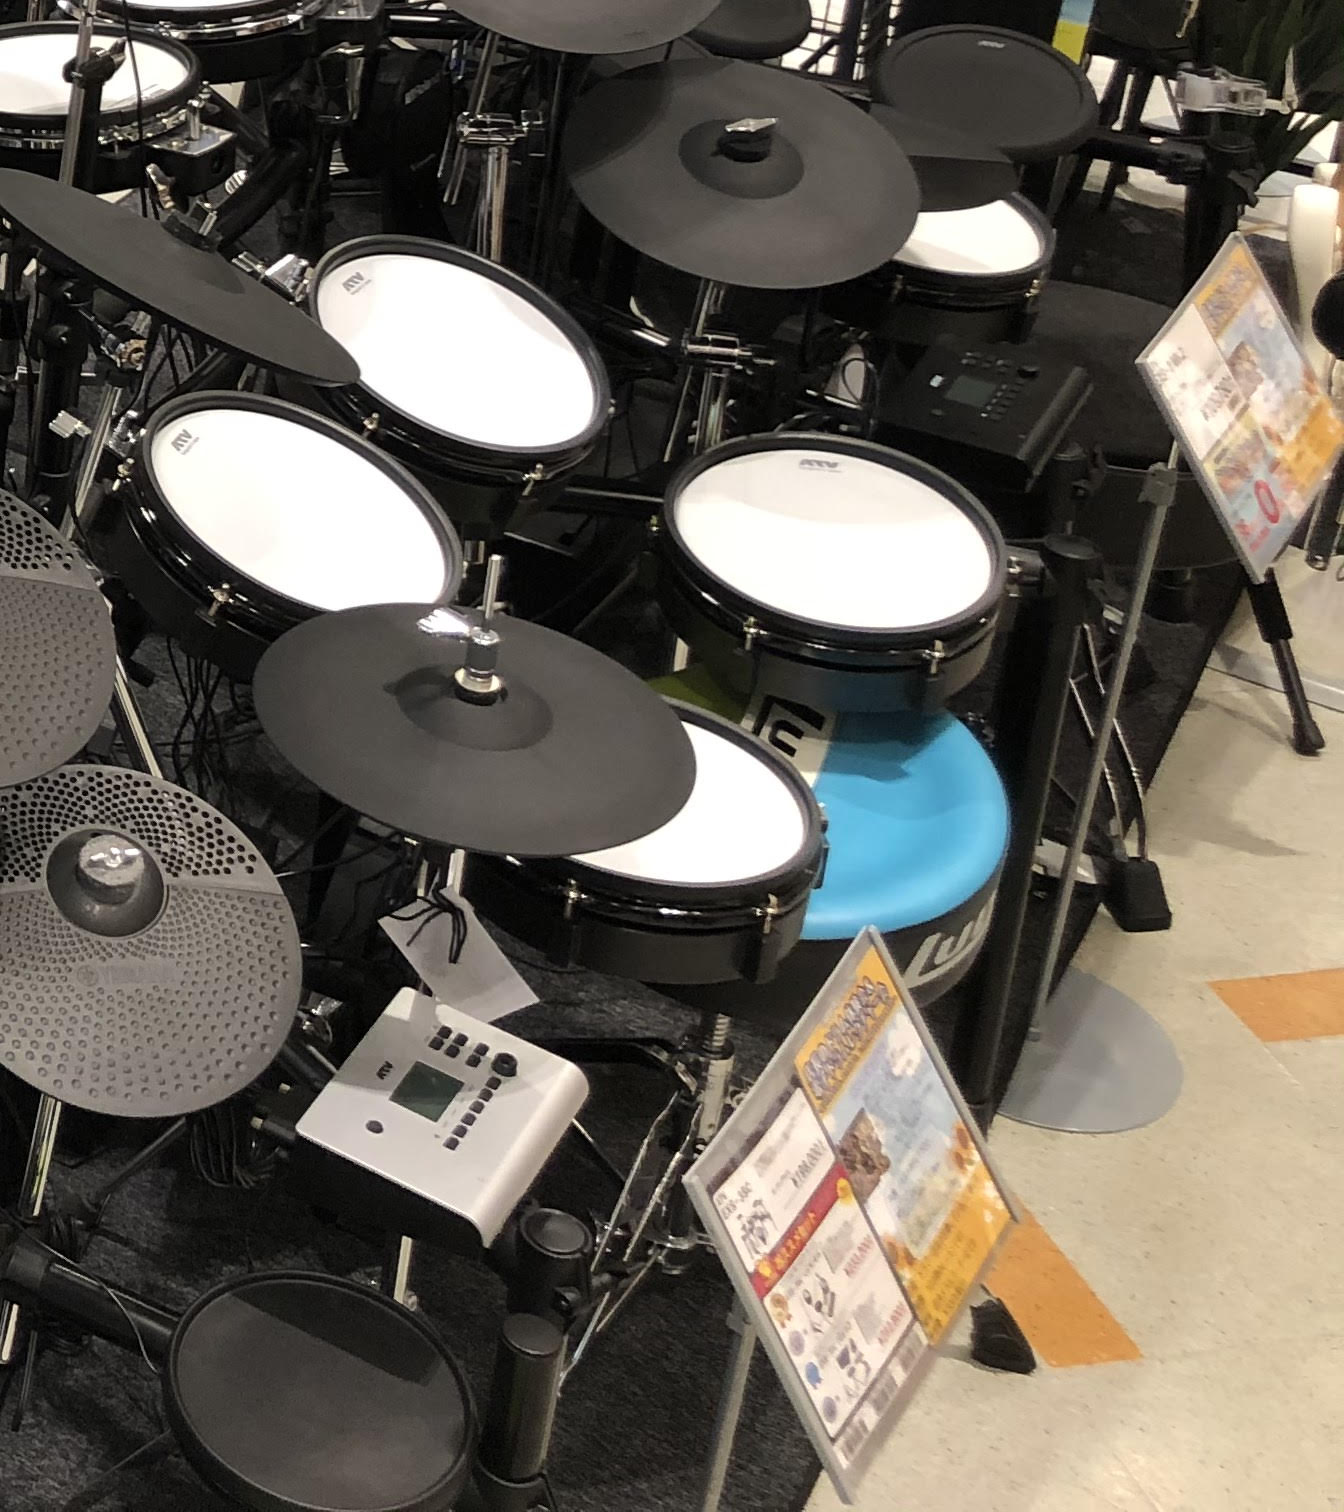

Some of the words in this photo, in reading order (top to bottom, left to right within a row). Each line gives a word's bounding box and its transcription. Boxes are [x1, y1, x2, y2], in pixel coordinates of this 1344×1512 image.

[342, 271, 365, 293] ATV
[171, 428, 193, 452] ATV
[376, 1061, 395, 1081] ATV
